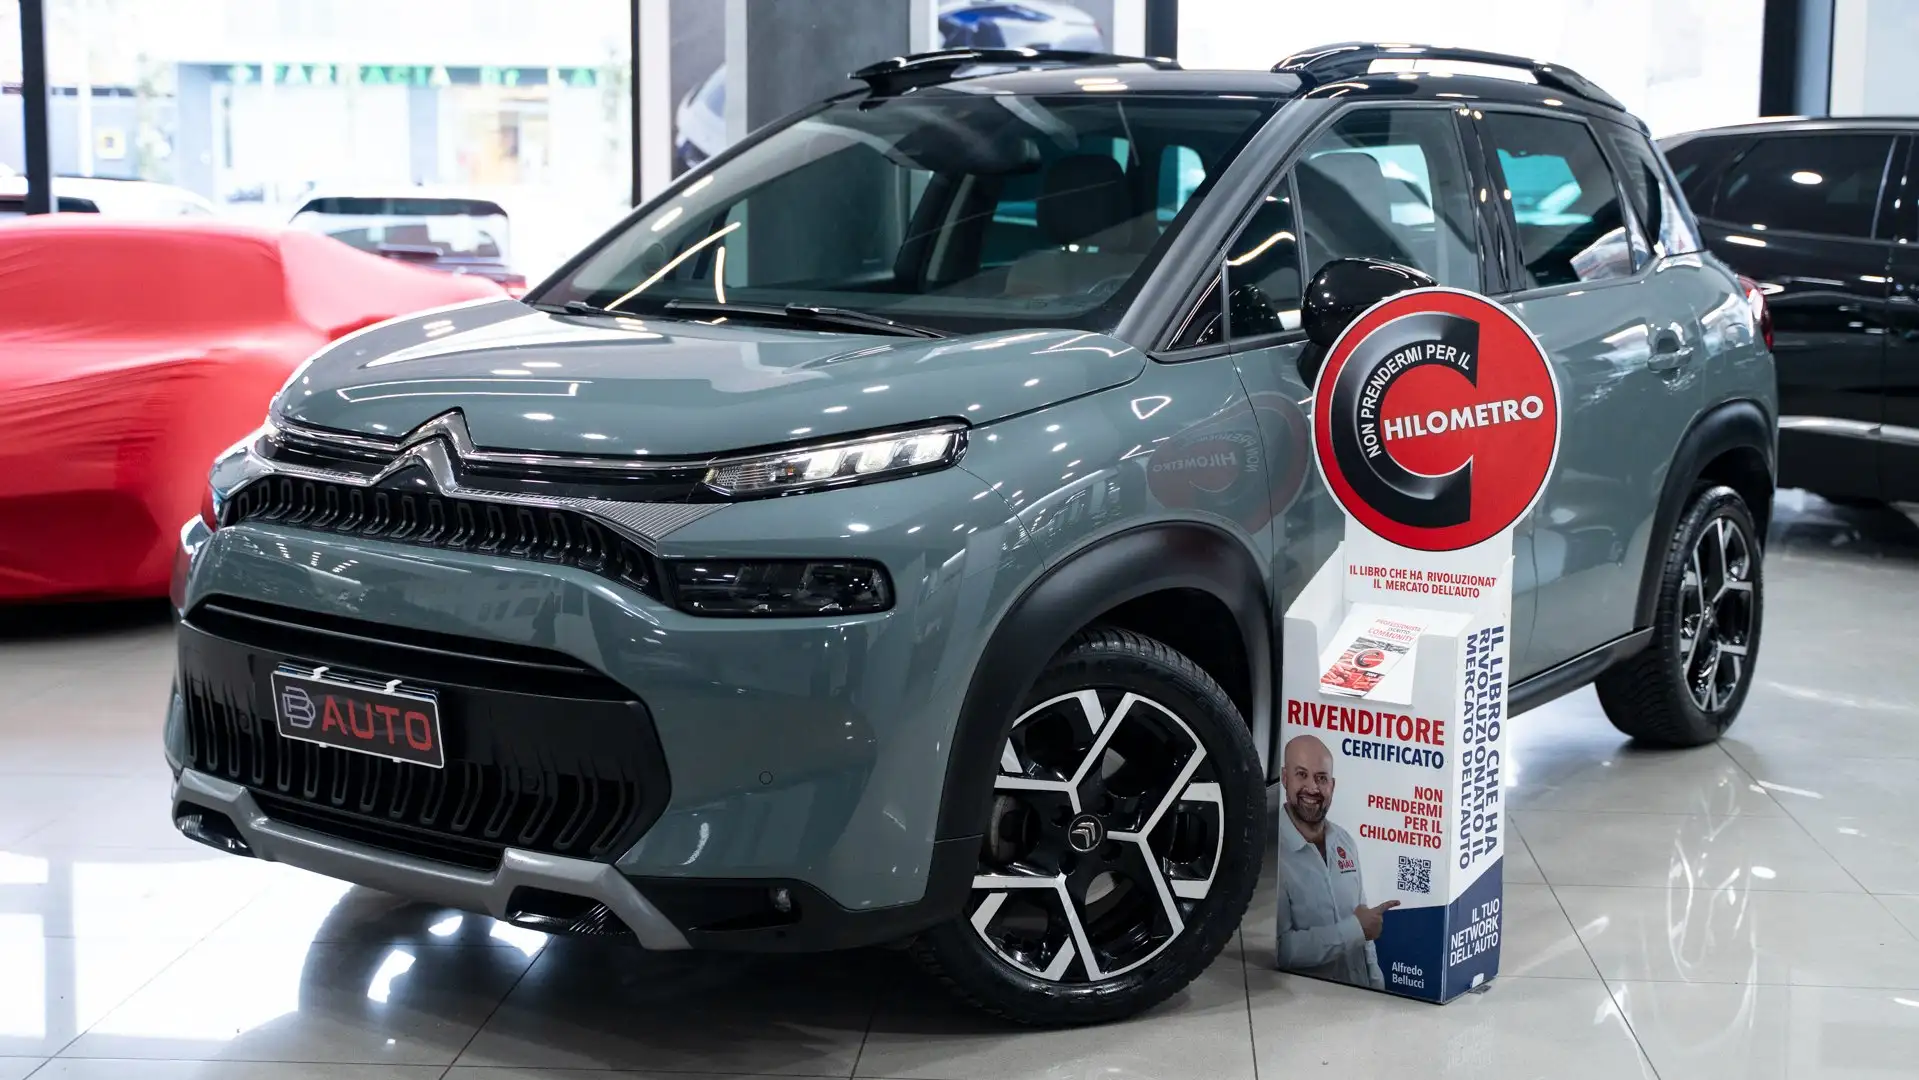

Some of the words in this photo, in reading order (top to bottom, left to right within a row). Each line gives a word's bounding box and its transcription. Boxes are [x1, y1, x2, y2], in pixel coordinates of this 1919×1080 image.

[1426, 344, 1457, 362] PER
[1458, 351, 1471, 371] IL
[1361, 345, 1422, 419] PRENDERMI
[1361, 423, 1382, 458] NON
[1349, 564, 1358, 575] IL
[1360, 565, 1387, 578] LIBRO
[1389, 568, 1408, 580] CHE
[1410, 570, 1423, 581] HA
[1427, 571, 1497, 588] RIVOLUZIONAT
[1373, 579, 1382, 589] IL
[1385, 579, 1430, 594] MERCATO
[1431, 584, 1480, 599] DELL'AUTO
[1368, 628, 1416, 641] COMMUNITY
[1491, 625, 1504, 651] IL
[1463, 633, 1478, 745] MERCATO
[1487, 656, 1503, 742] LIBRO
[321, 694, 433, 752] AUTO
[1287, 699, 1445, 746] RIVENDITORE
[1473, 627, 1490, 833] RIVOLUZIONATO
[1341, 738, 1444, 769] CERTIFICATO
[1485, 750, 1500, 807] CHE
[1367, 794, 1443, 818] PRENDERMI
[1414, 786, 1443, 803] NON
[1459, 750, 1473, 870] DELL'AUTO
[1359, 823, 1442, 849] CHILOMETRO
[1404, 815, 1428, 832] PER
[1431, 820, 1443, 834] IL
[1485, 812, 1498, 855] HA
[1472, 838, 1484, 863] IL
[1471, 907, 1480, 924] IL
[1481, 898, 1500, 919] TUO
[1450, 914, 1499, 950] NETWORK
[1450, 932, 1499, 967] DELL'AUTO
[1391, 961, 1423, 976] Alfredo
[1392, 973, 1425, 989] Bellucci
